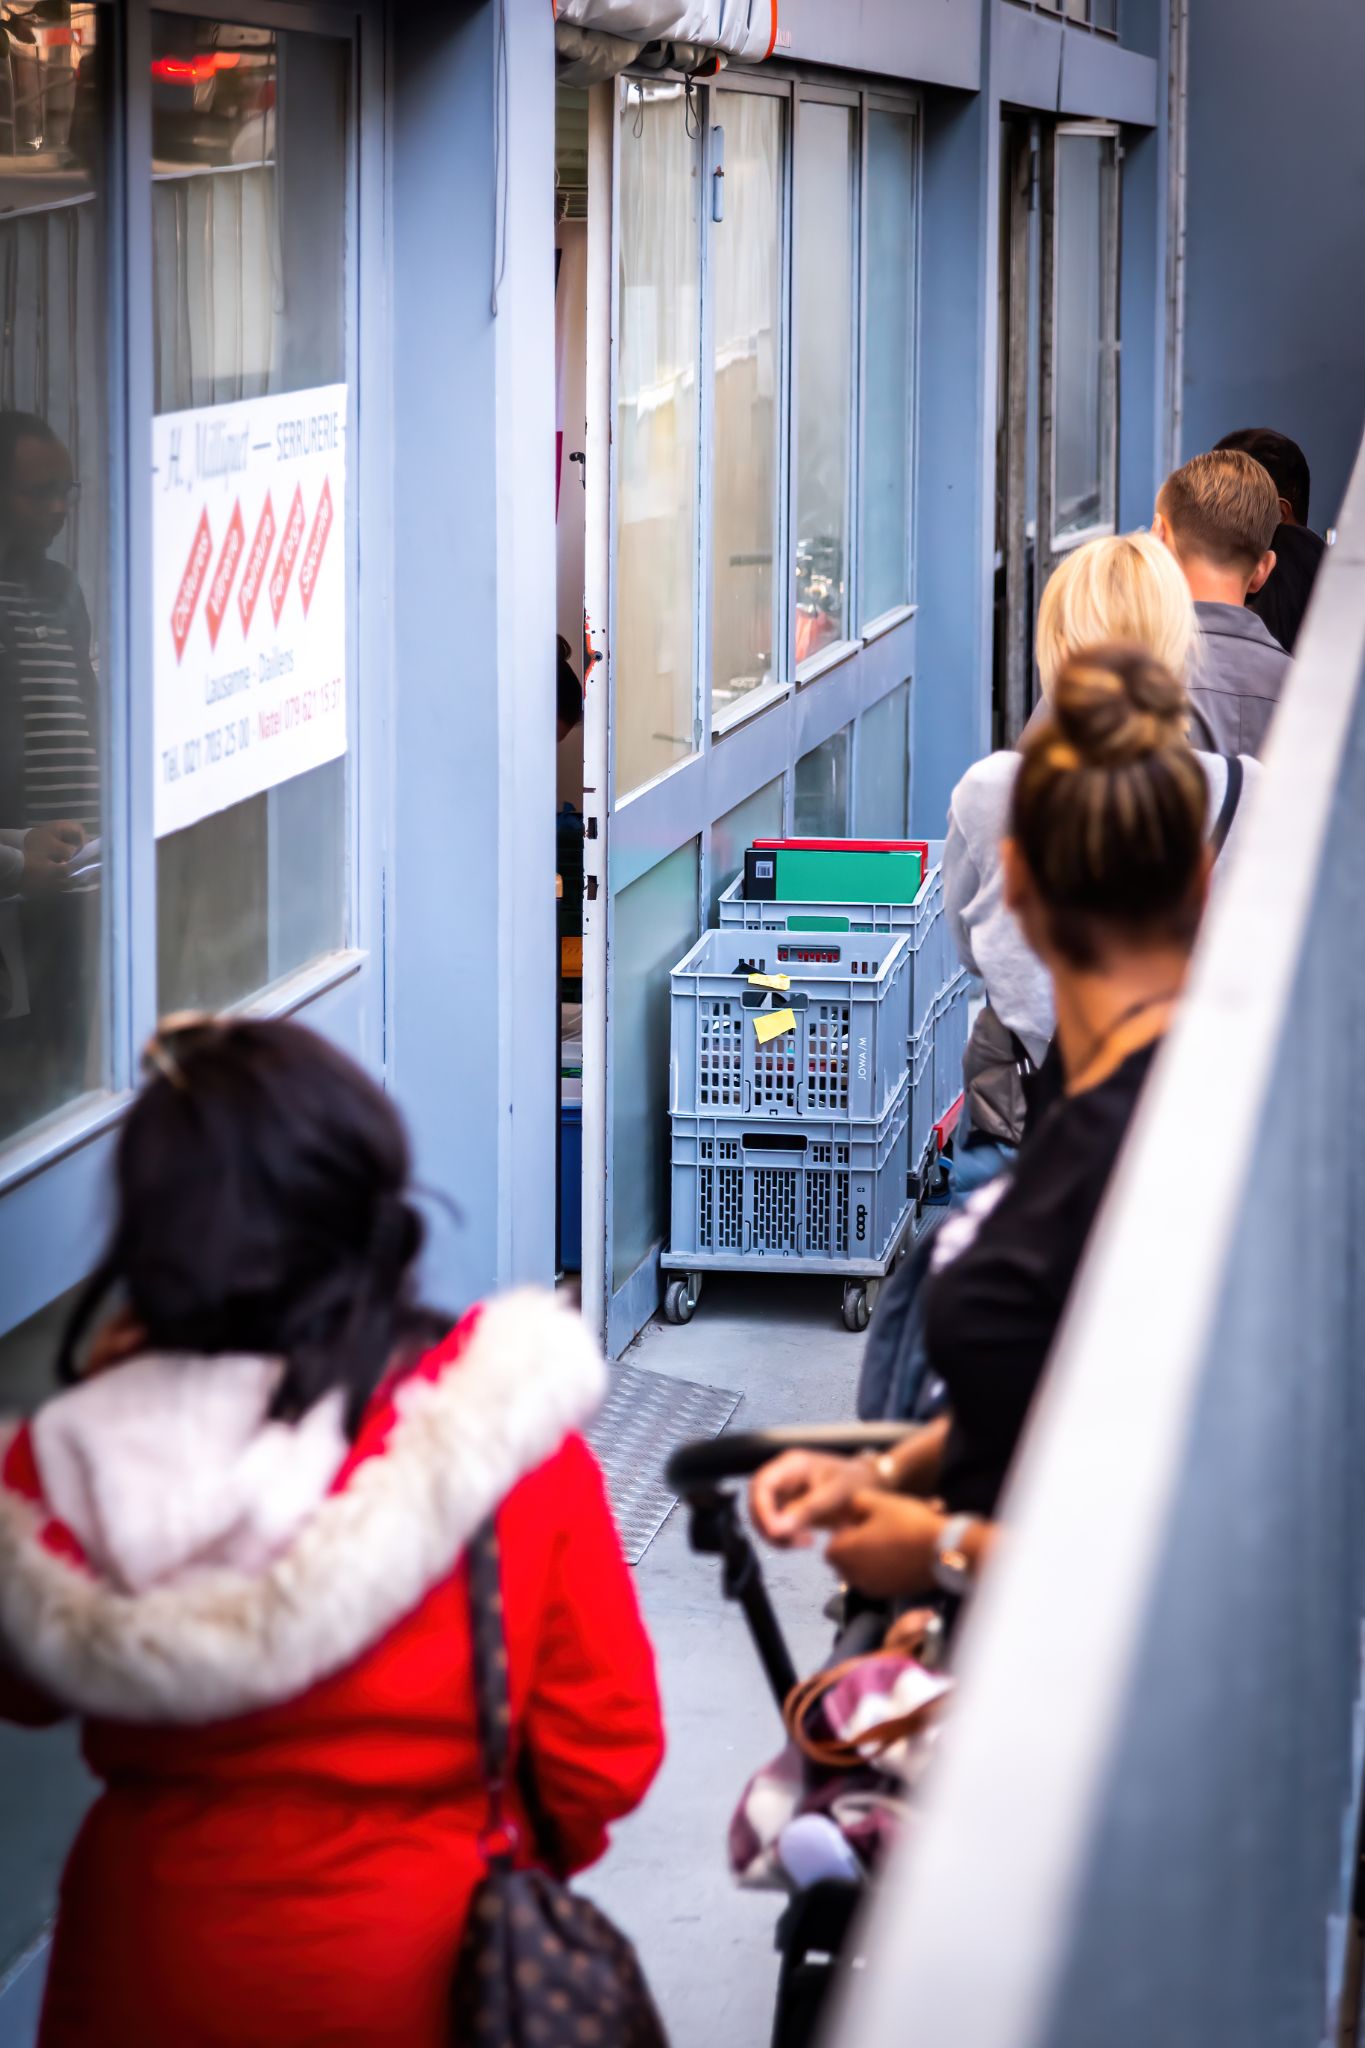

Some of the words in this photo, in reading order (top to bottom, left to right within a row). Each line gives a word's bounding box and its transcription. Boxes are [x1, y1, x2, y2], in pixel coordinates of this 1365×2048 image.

[276, 412, 338, 461] SERRURERIE
[205, 666, 250, 705] Lausanne
[284, 695, 300, 730] 079
[857, 1037, 867, 1081] JOWA/M
[856, 1204, 868, 1241] coop
